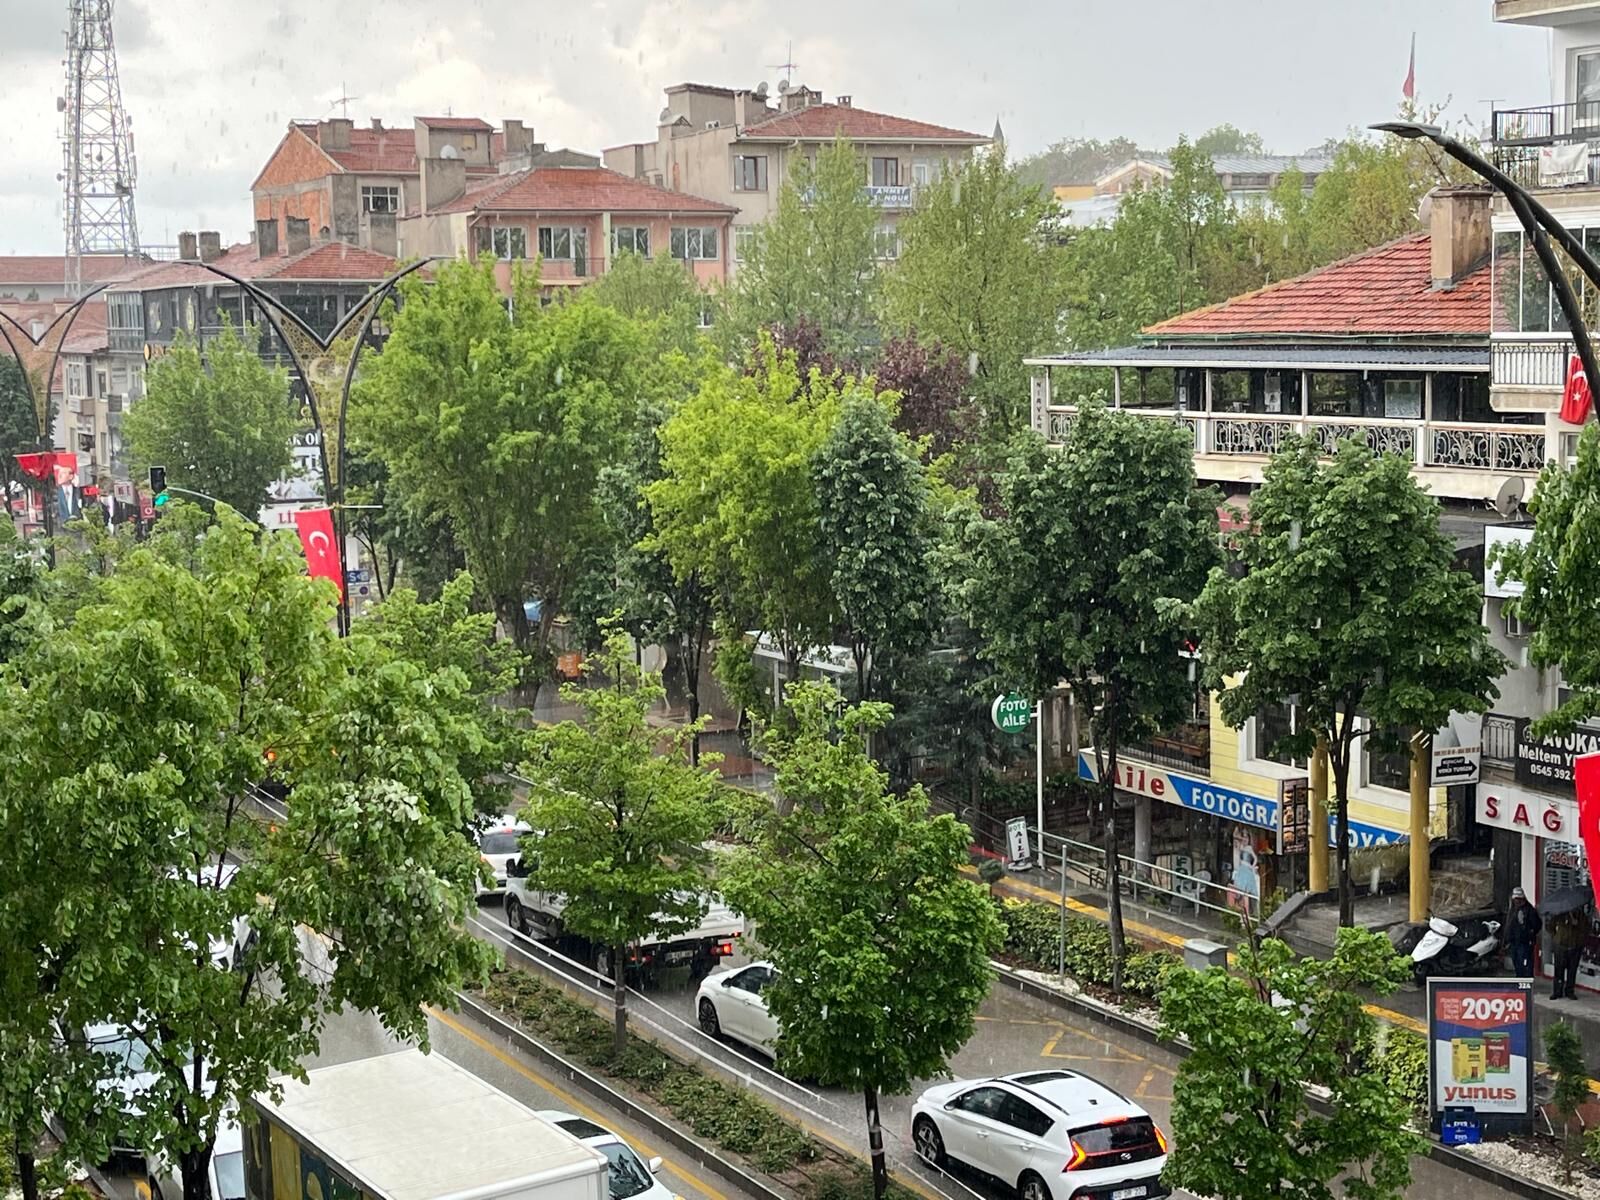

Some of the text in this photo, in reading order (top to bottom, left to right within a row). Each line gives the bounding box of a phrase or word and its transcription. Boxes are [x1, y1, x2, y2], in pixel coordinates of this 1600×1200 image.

[1000, 699, 1027, 713] FOTO
[1002, 713, 1027, 728] AİLE
[1542, 729, 1600, 753] AVOKA
[1518, 743, 1562, 766] Meltem
[1530, 763, 1571, 781] 0545 392
[1444, 1086, 1517, 1102] yunus
